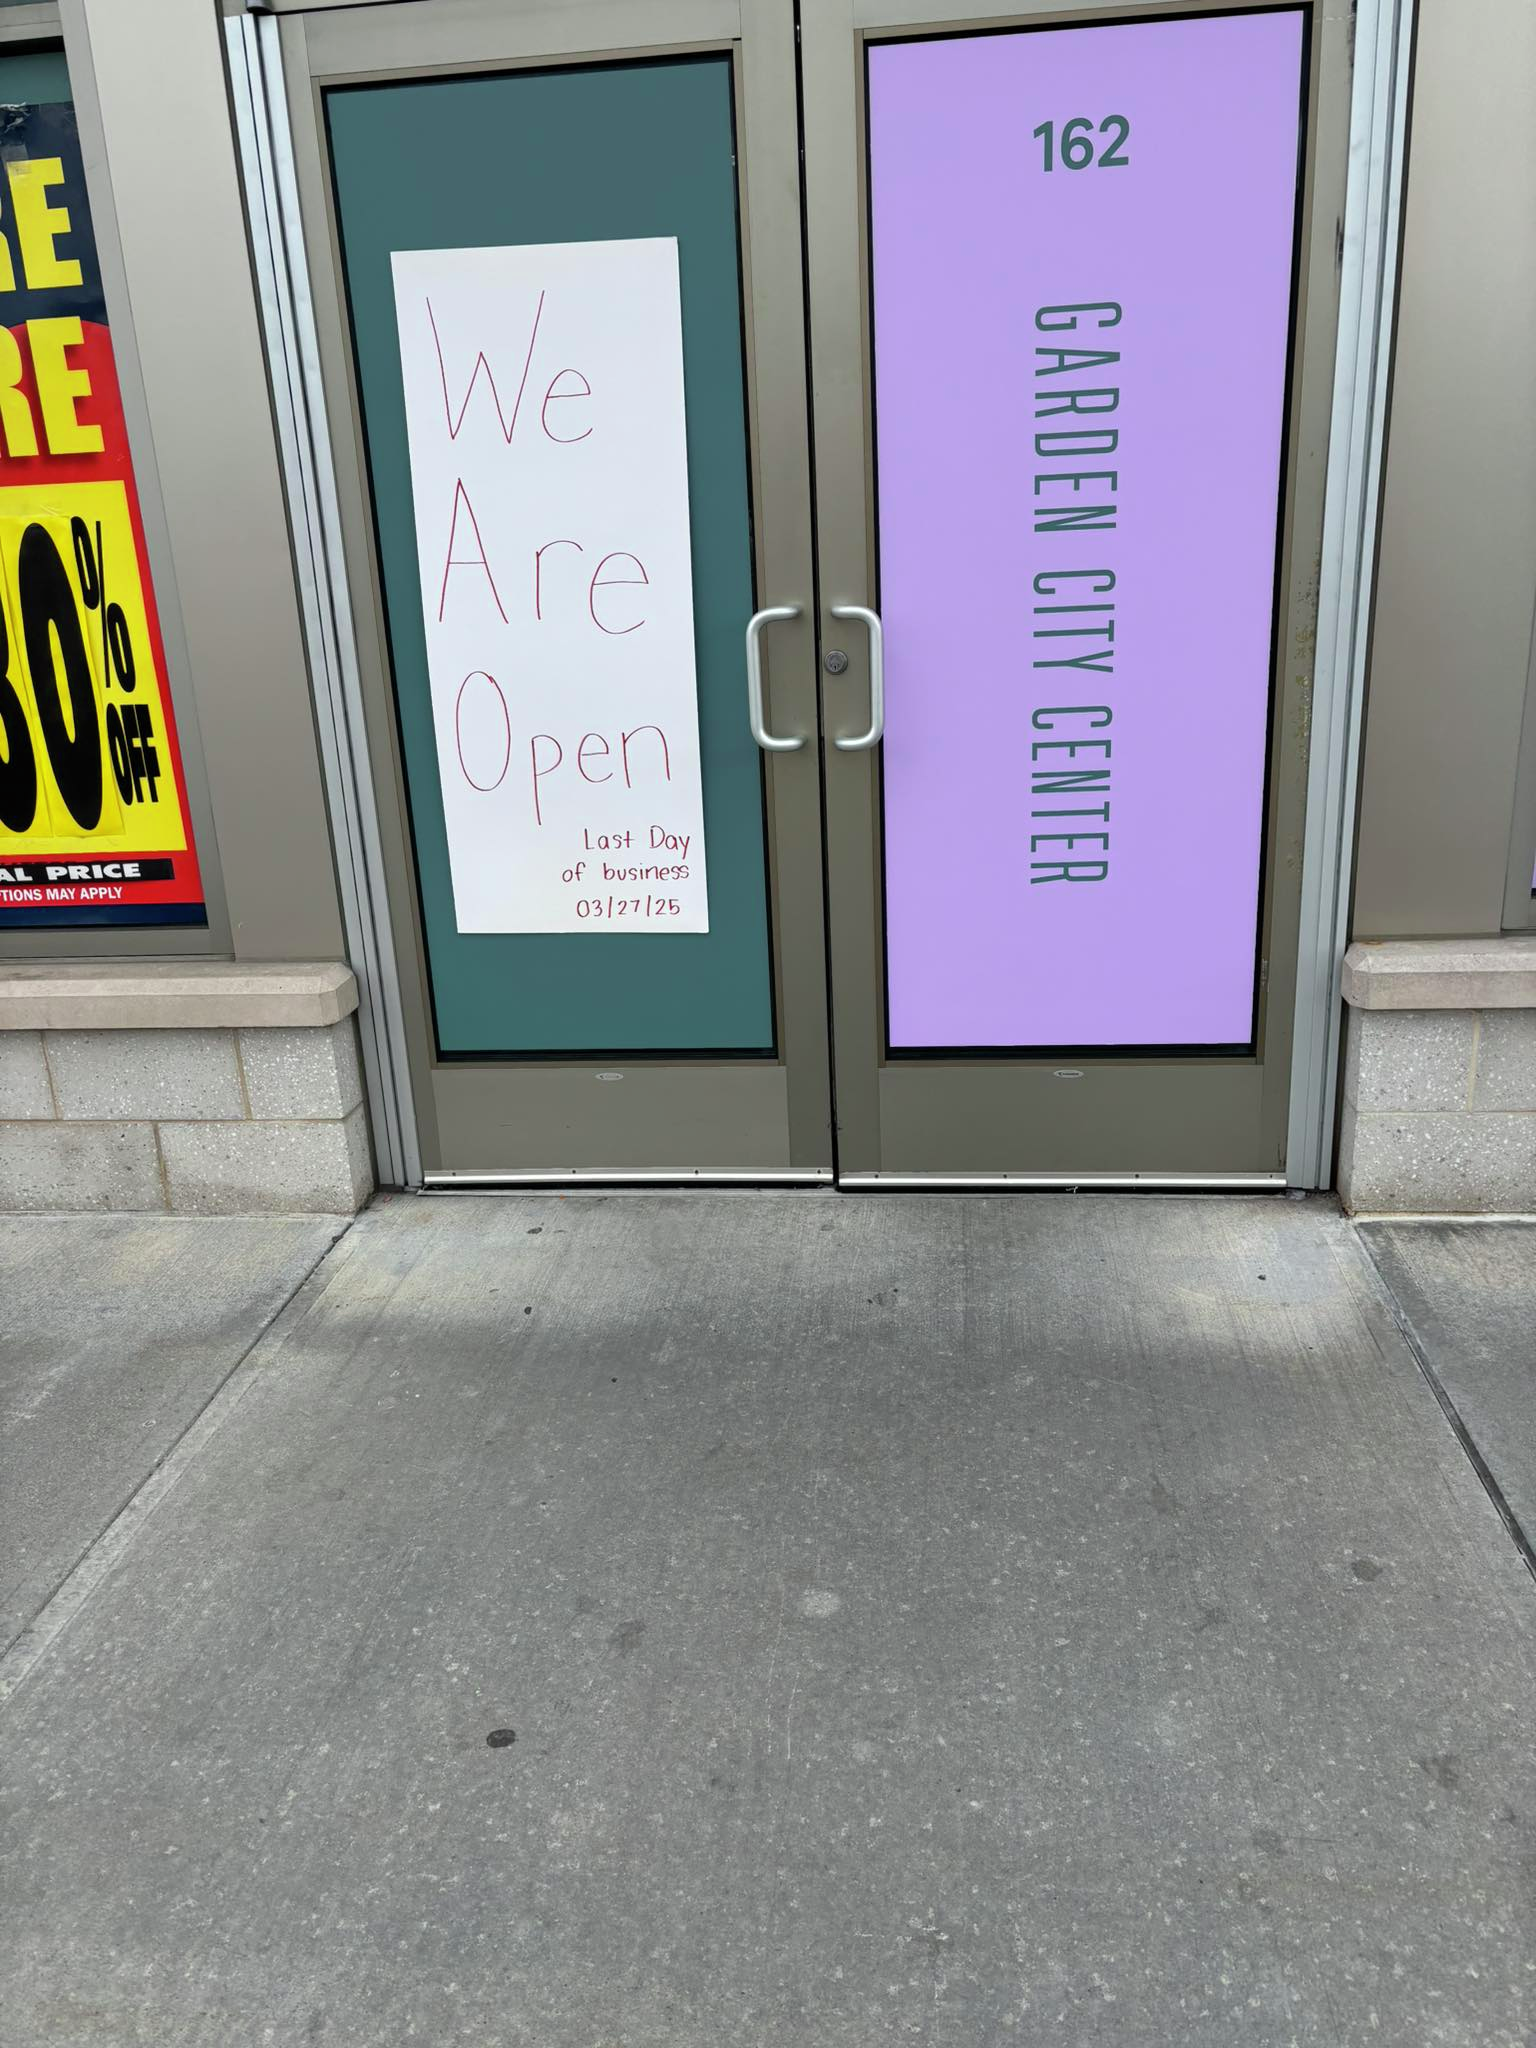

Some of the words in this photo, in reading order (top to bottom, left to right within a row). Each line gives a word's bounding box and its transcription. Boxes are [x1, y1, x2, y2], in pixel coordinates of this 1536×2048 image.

[1033, 114, 1130, 171] 162
[0, 157, 83, 292] E
[426, 290, 593, 444] We
[1034, 301, 1123, 533] GARDEN
[439, 478, 649, 635] Are
[1032, 568, 1117, 674] CITY
[106, 702, 161, 806] OFF
[456, 671, 670, 826] Open
[1030, 704, 1114, 885] CENTER
[0, 889, 42, 902] TIONS
[46, 887, 76, 901] MAY
[80, 886, 123, 900] APPLY
[46, 862, 141, 881] PRICE
[562, 861, 586, 883] of
[603, 862, 690, 881] business
[584, 828, 635, 850] Last
[649, 825, 690, 860] Day
[576, 895, 681, 919] 03/27/25
